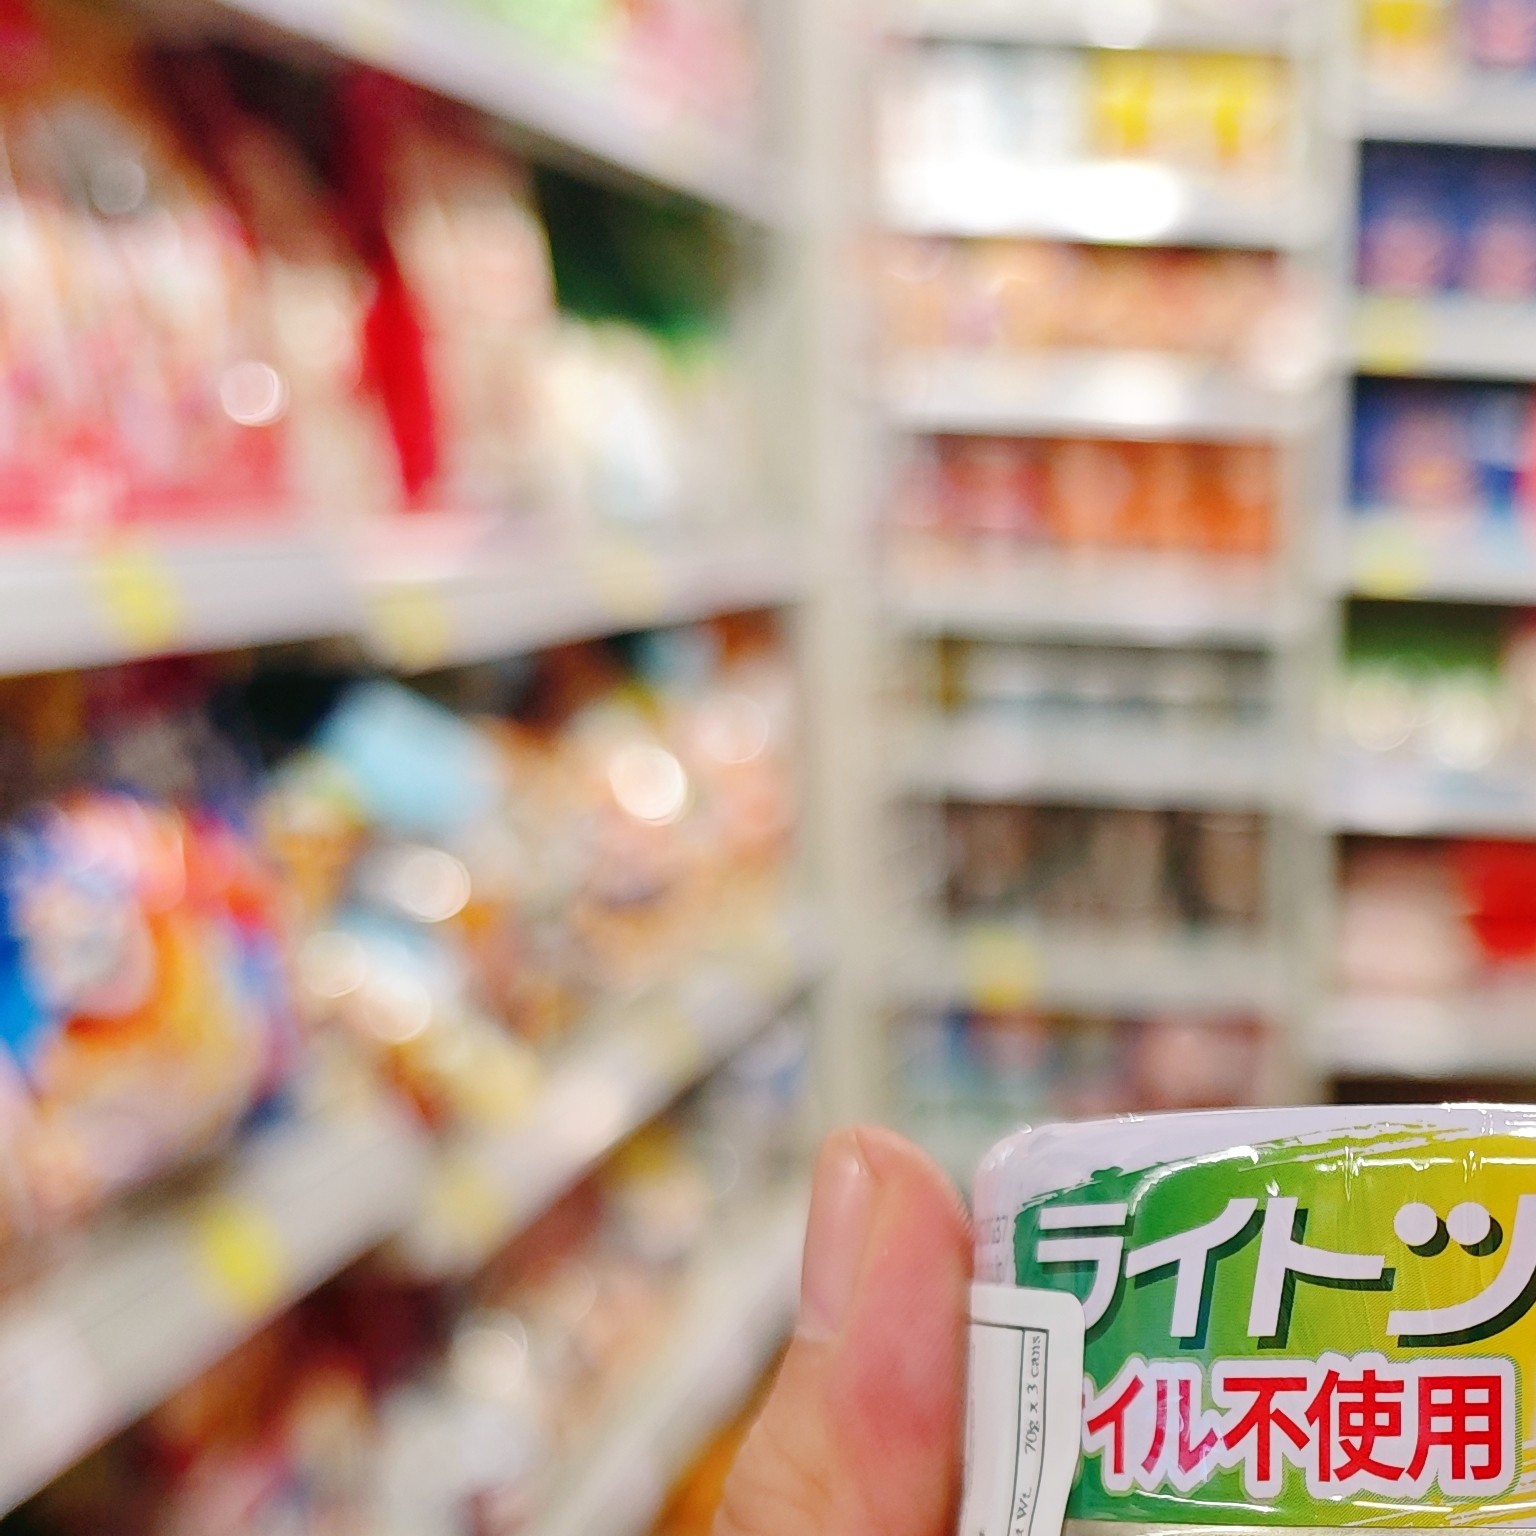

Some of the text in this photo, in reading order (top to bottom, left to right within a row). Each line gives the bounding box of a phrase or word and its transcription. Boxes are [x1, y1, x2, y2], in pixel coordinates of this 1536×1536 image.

[1082, 1368, 1503, 1484] イル不使用
